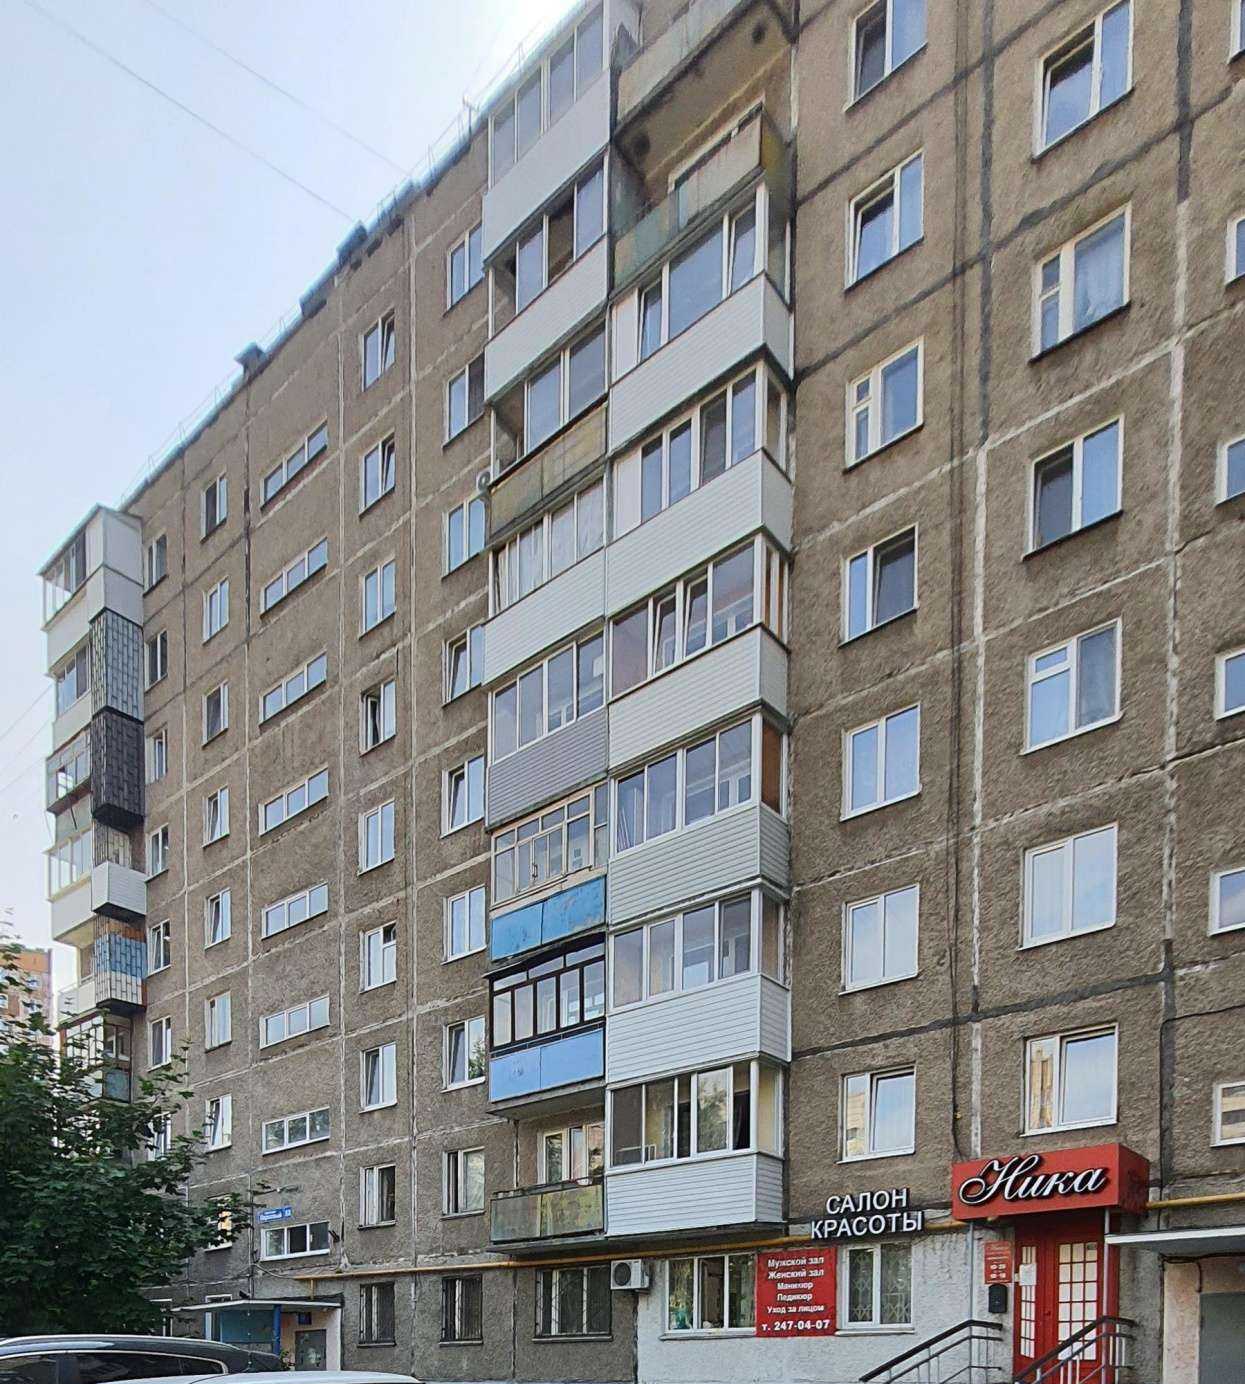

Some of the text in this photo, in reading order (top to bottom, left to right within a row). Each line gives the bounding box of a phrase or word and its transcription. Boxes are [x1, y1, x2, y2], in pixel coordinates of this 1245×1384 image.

[958, 1154, 1108, 1205] Ника
[825, 1187, 908, 1215] САЛОН
[810, 1211, 924, 1239] КРАСОТЫ
[767, 1257, 824, 1268] Мужской зал
[767, 1269, 824, 1279] Женский зал
[767, 1306, 786, 1314] Уход
[798, 1305, 824, 1313] лицом
[761, 1320, 830, 1331] т. 247-04-07
